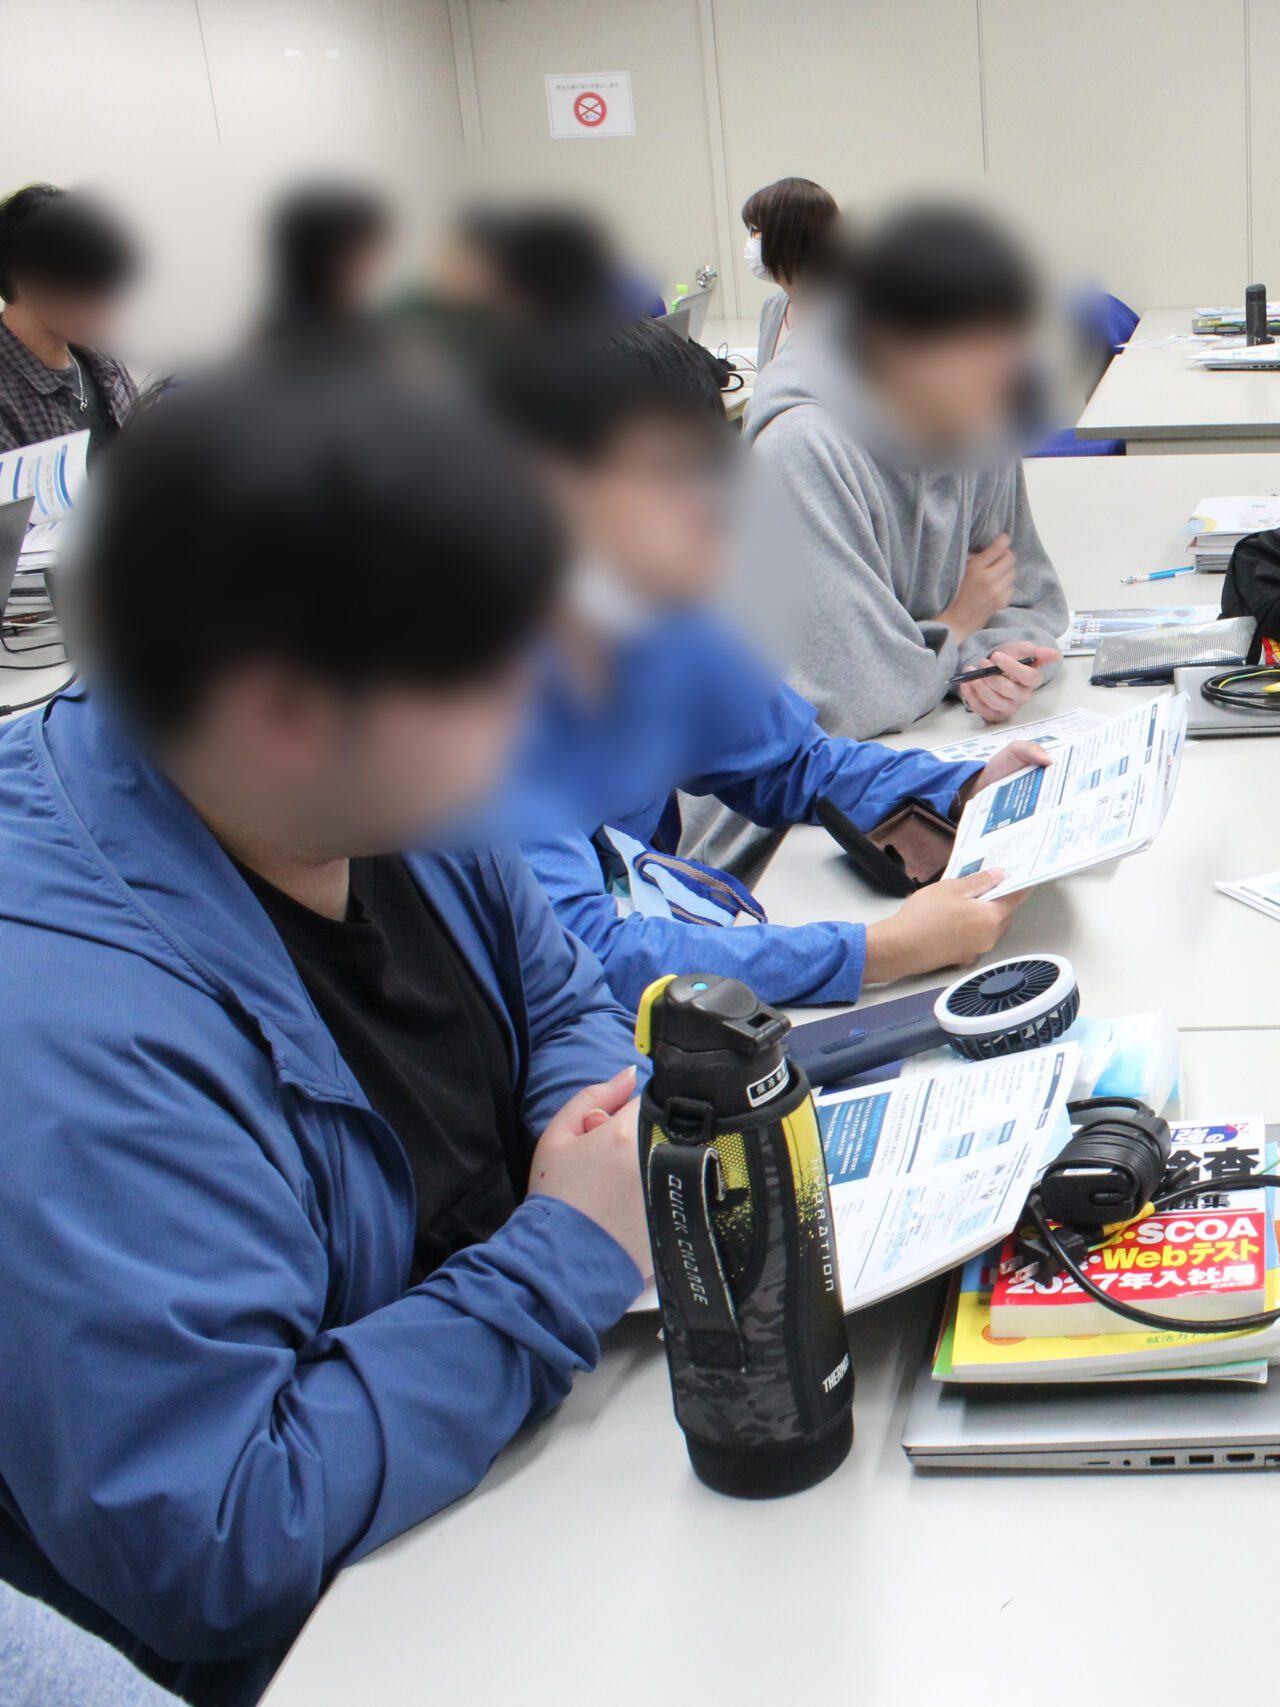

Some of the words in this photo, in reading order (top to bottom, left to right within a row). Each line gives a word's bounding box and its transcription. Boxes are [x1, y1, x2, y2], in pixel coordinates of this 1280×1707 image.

[1170, 1127, 1225, 1144] 強の
[668, 1173, 689, 1234] QUICK
[811, 1157, 835, 1293] HYDRATION
[1102, 1238, 1260, 1271] Webテスト
[1137, 1217, 1258, 1245] SCOA
[677, 1239, 709, 1306] CHARGE
